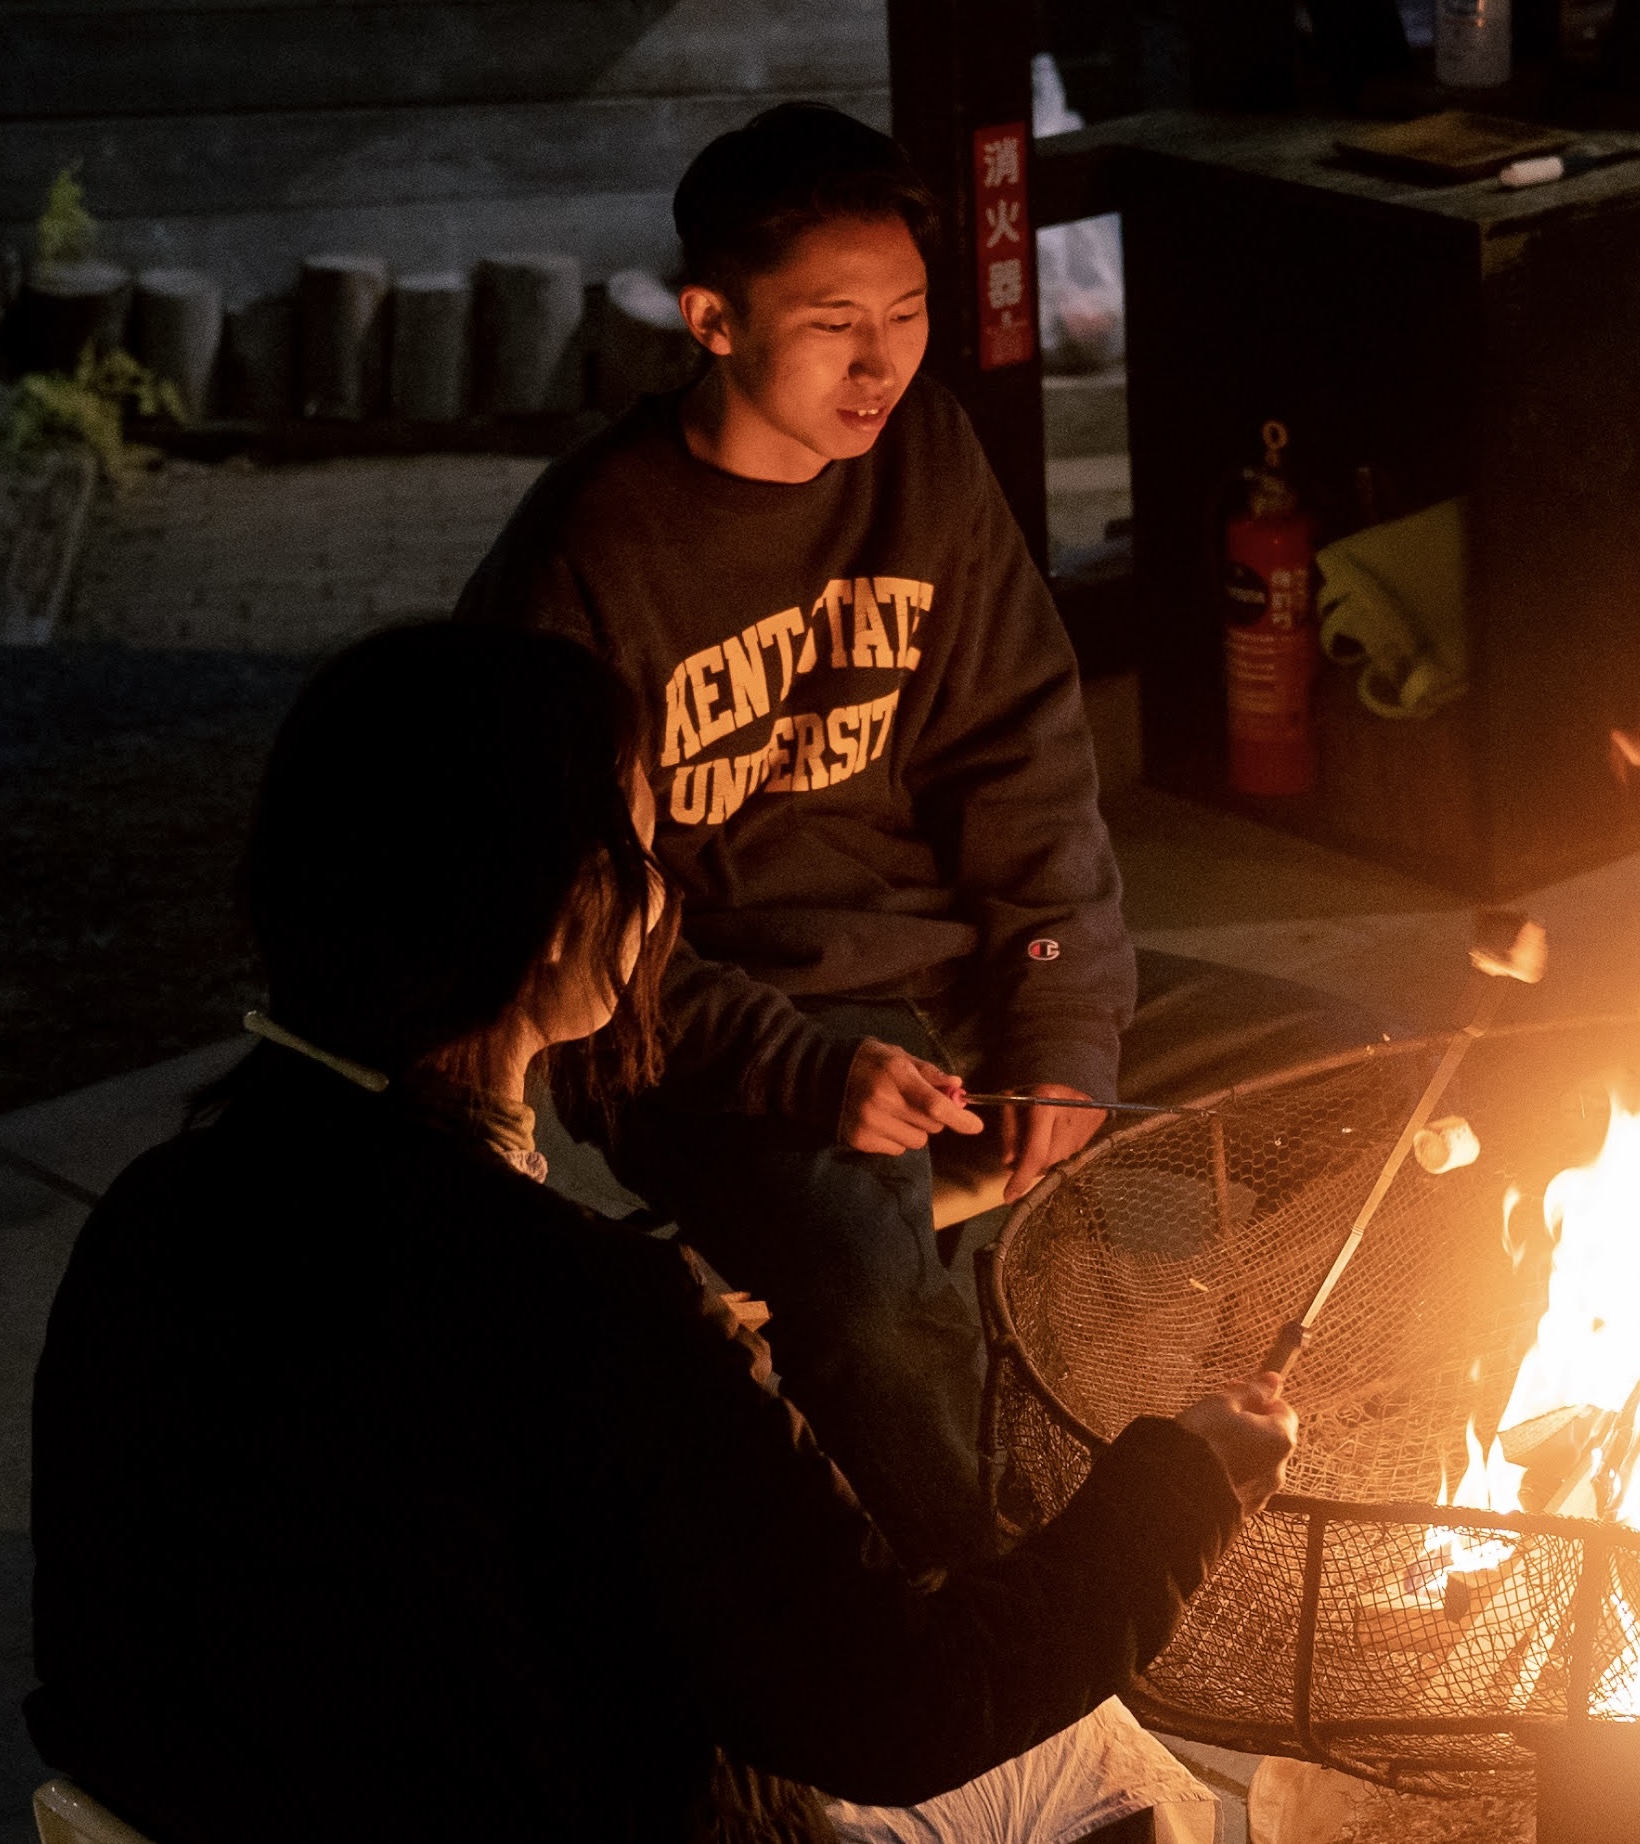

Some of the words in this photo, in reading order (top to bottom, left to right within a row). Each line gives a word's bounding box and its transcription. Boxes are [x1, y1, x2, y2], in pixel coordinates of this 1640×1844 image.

[983, 136, 1022, 310] 消火器
[660, 606, 806, 768] KENT
